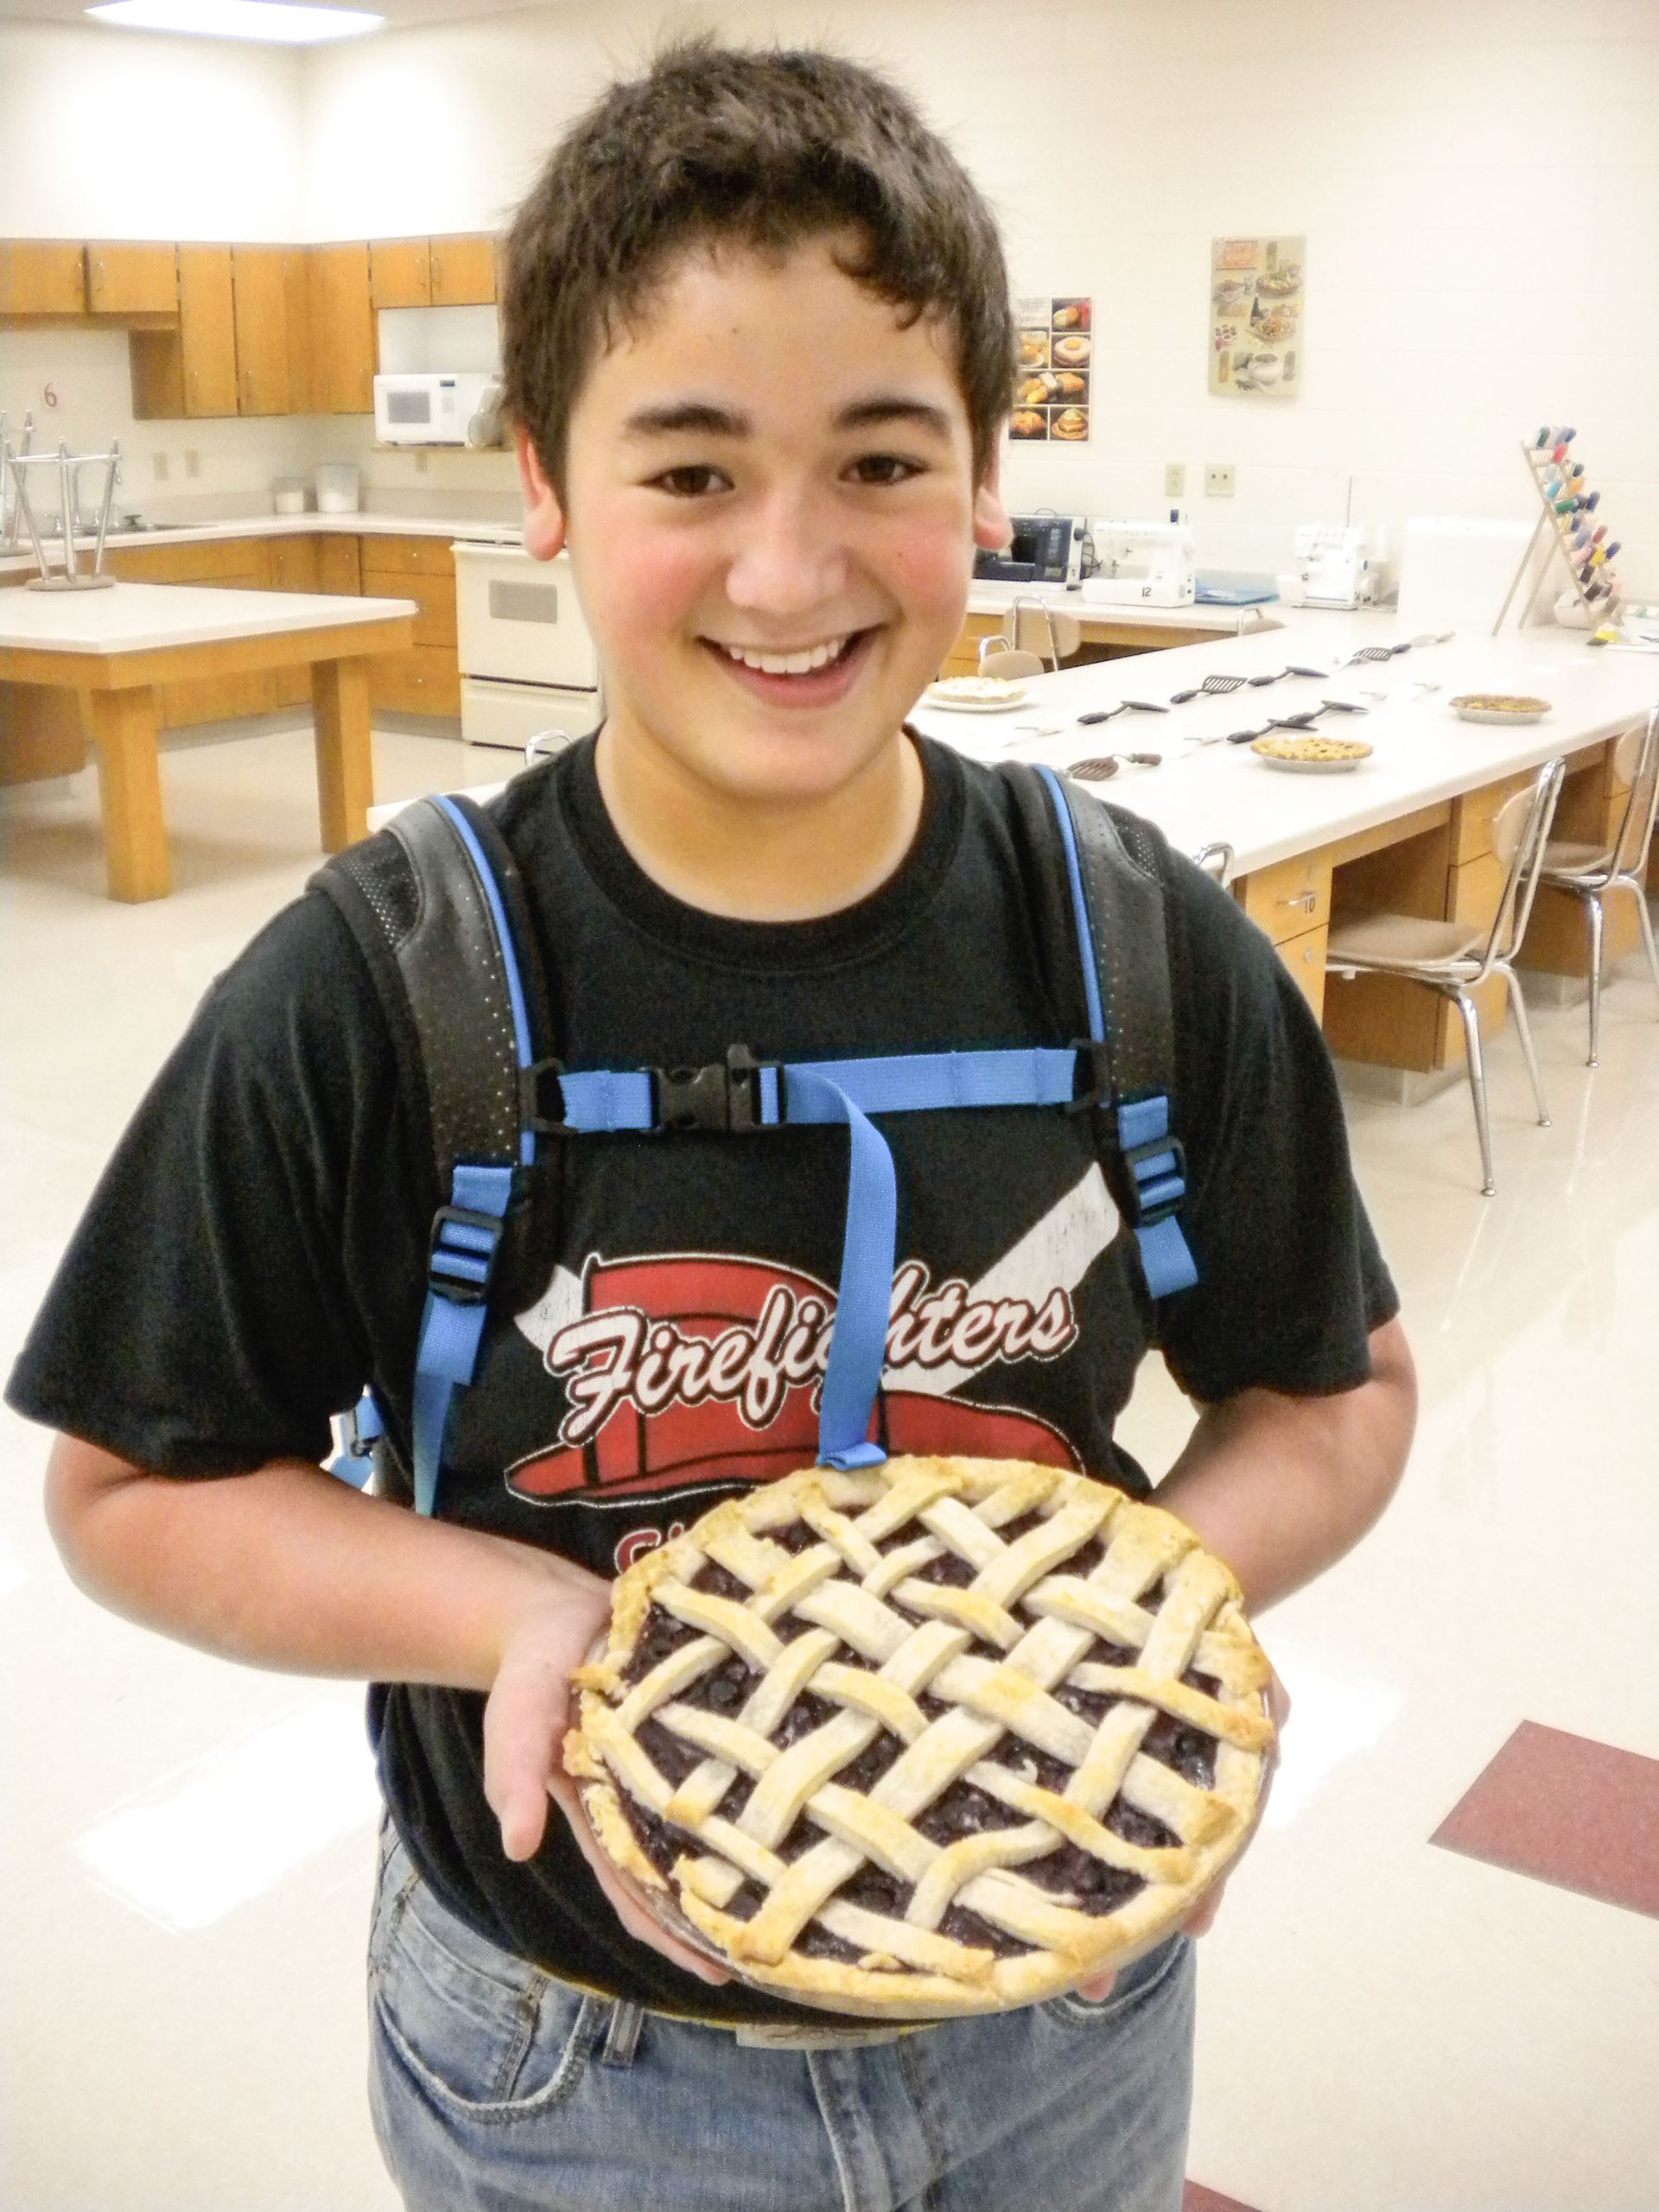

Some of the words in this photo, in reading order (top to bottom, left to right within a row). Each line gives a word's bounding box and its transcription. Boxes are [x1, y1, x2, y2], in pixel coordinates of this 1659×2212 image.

[44, 381, 57, 407] 6
[1141, 586, 1152, 598] 12
[544, 1261, 1077, 1446] Firefihters
